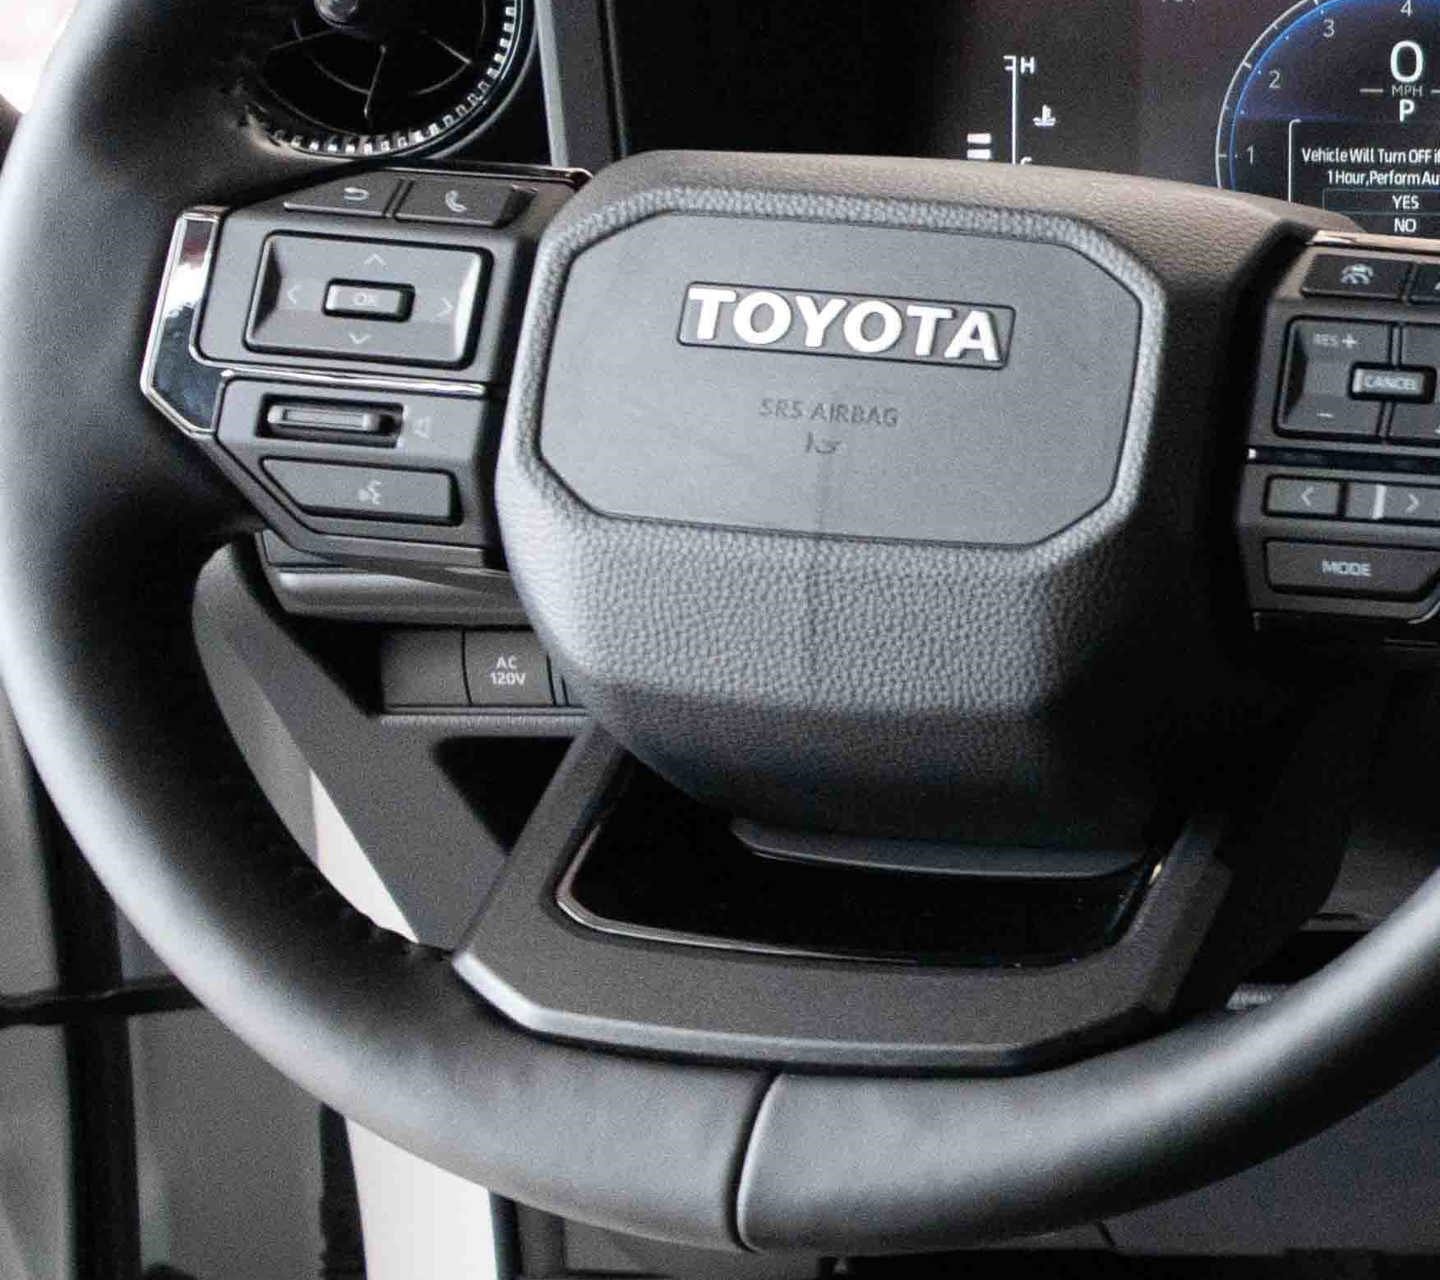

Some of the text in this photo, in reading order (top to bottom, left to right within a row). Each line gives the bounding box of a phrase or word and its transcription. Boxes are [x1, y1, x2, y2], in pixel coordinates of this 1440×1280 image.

[1400, 0, 1413, 17] 4
[1322, 19, 1336, 38] 3
[1019, 56, 1036, 74] H
[1389, 39, 1424, 83] 0
[1268, 70, 1281, 89] 2
[1391, 85, 1424, 98] MPH
[1399, 99, 1415, 122] P
[1245, 146, 1255, 165] 1
[1301, 147, 1348, 163] Vehicle
[1350, 147, 1374, 164] Will
[1378, 148, 1406, 165] Turn
[1408, 148, 1432, 165] OFF
[1434, 148, 1440, 165] if
[1391, 194, 1420, 210] YES
[1393, 218, 1417, 234] NO
[686, 286, 1001, 362] TOYOTA
[757, 396, 902, 427] SRS AIRBAG
[1321, 559, 1372, 577] MODE
[495, 656, 518, 670] AC
[489, 671, 527, 686] 120V
